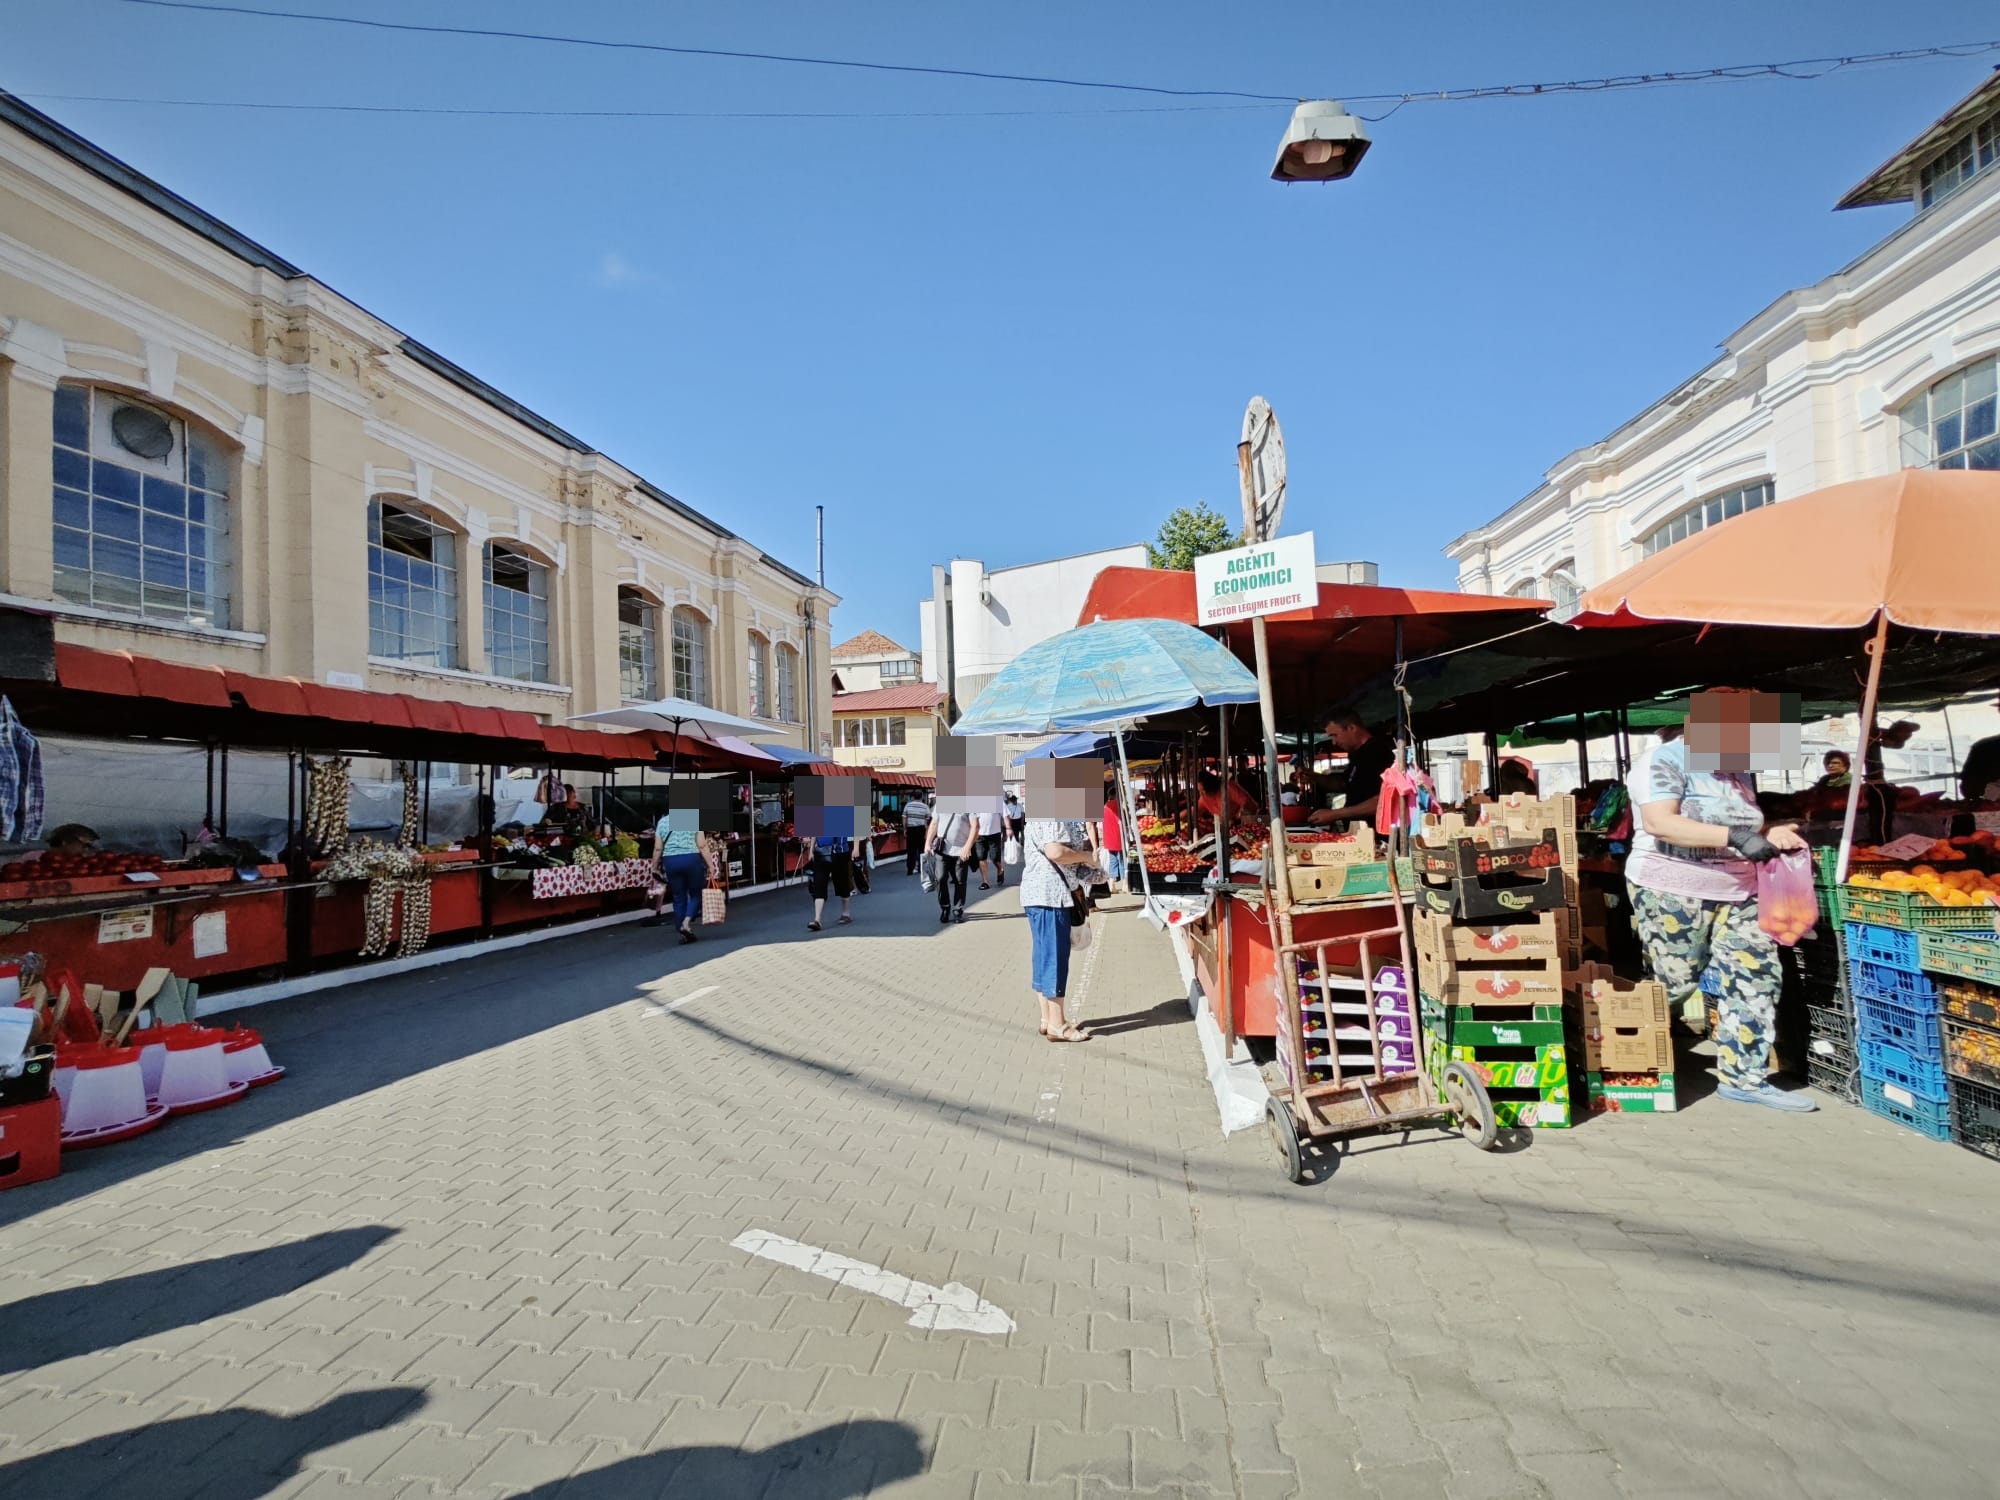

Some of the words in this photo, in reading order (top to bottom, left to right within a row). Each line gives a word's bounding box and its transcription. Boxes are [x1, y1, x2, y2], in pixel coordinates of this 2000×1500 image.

[1227, 551, 1275, 575] AGENTI
[1214, 567, 1292, 595] ECONOMICI
[1207, 605, 1237, 618] SECTOR
[1238, 599, 1269, 613] LEGUME
[1270, 593, 1302, 607] FRUCTE
[1434, 860, 1455, 870] paco
[1491, 852, 1527, 867] paco
